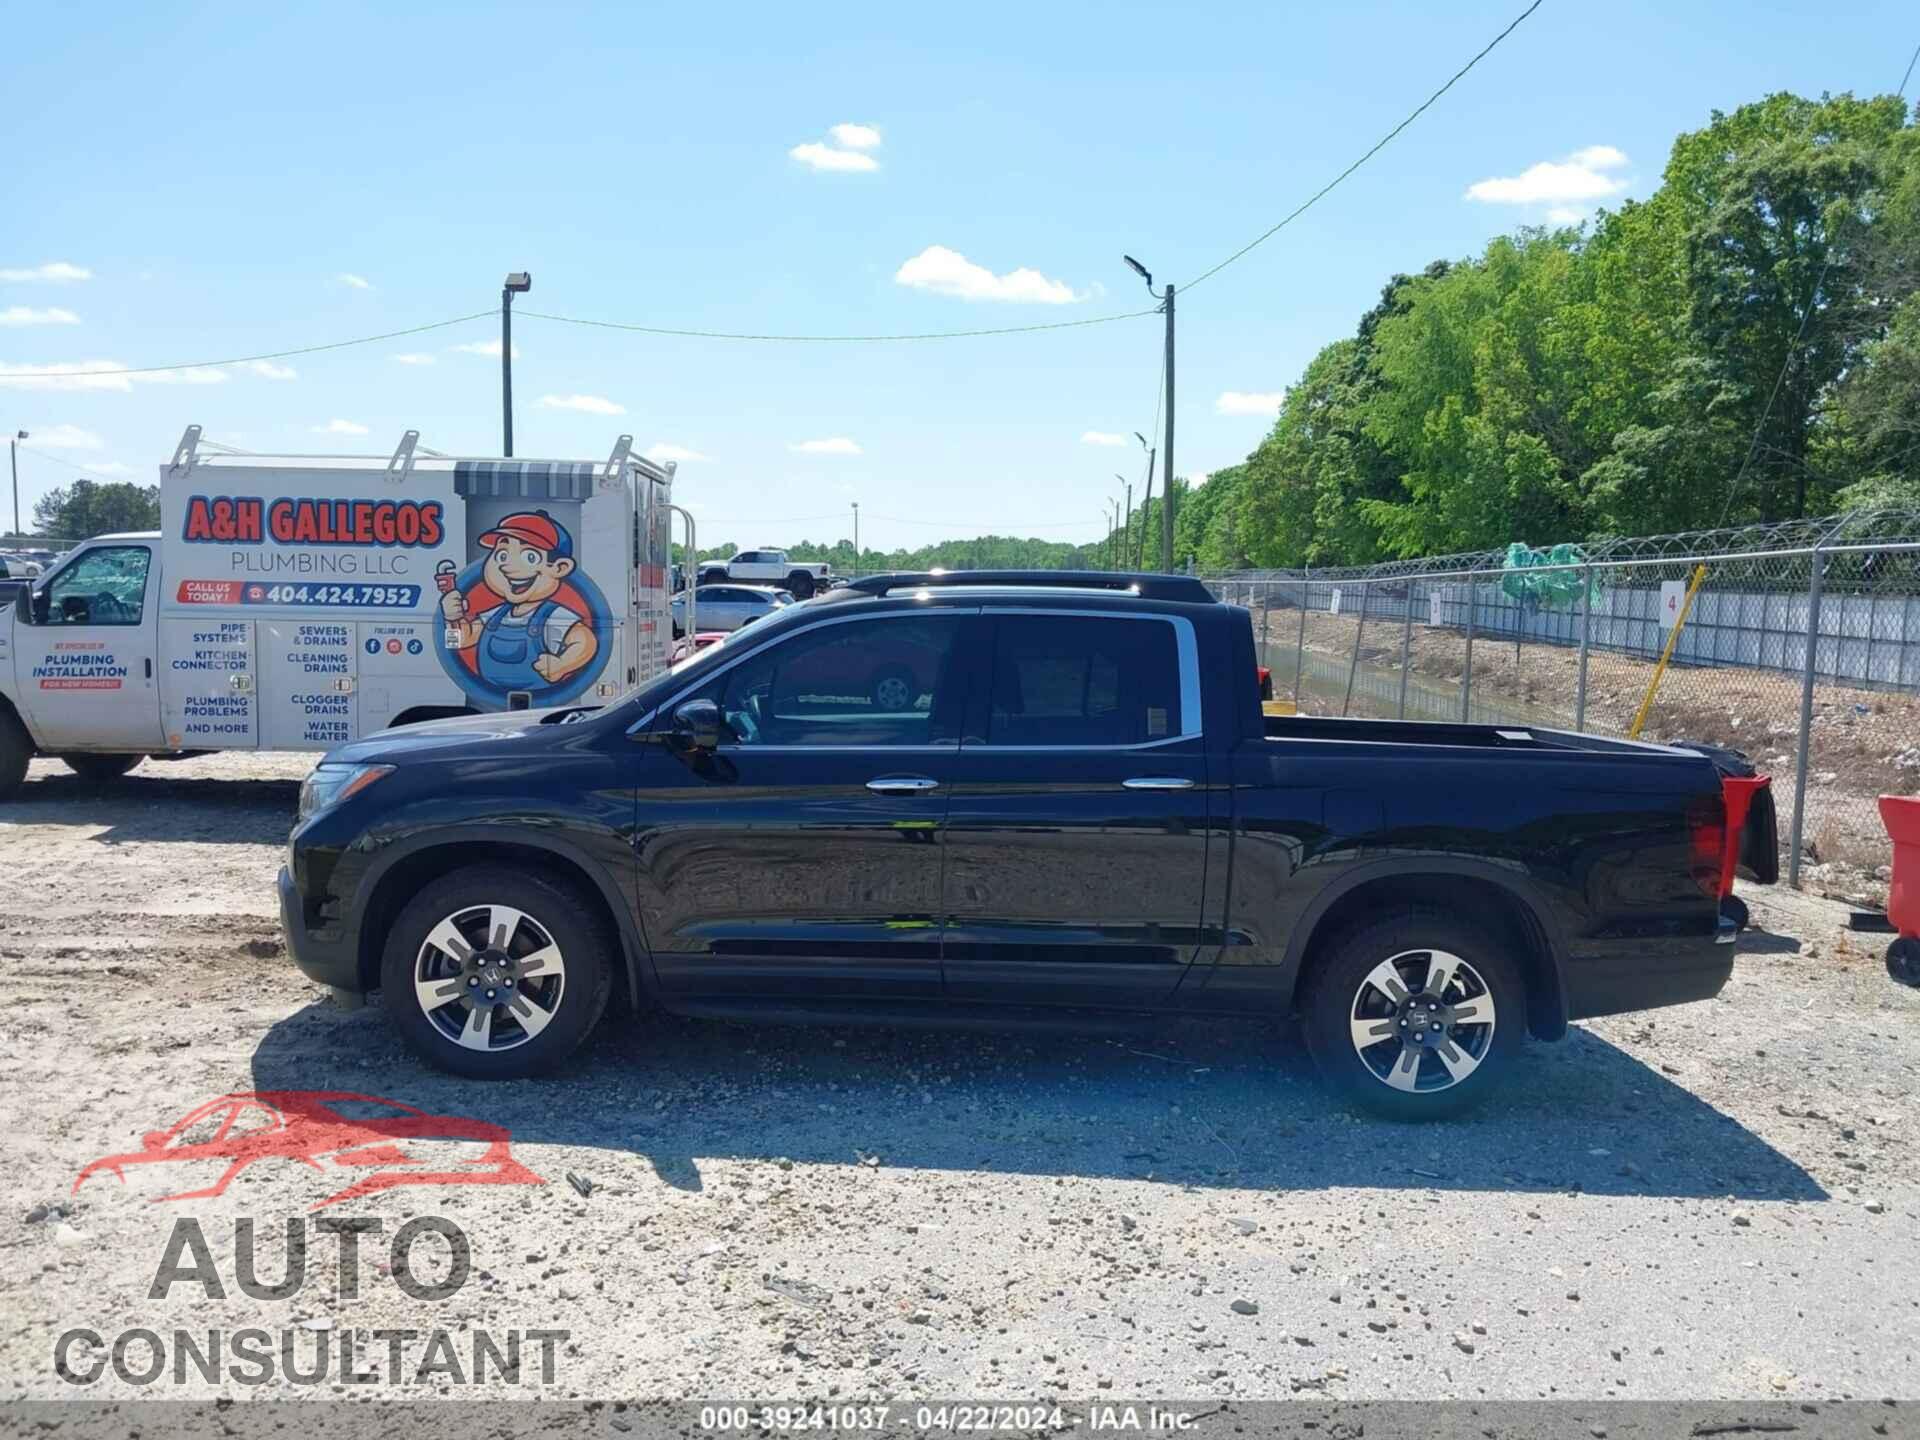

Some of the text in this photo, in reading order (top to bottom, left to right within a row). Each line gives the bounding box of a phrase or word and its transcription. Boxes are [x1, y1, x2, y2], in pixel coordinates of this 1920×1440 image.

[184, 496, 444, 548] A&H GALLEGOS
[232, 552, 409, 575] PLUMBING LLC
[187, 583, 231, 593] CALL US
[267, 586, 412, 604] 404.424.7952
[1668, 595, 1677, 611] 4
[221, 623, 246, 632] PIPE
[299, 626, 347, 635] SEWERS
[193, 633, 247, 642] SYSTEMS
[303, 637, 347, 646] DRAINS
[195, 650, 247, 660] KITCHEN
[287, 653, 347, 663] CLEANING
[45, 655, 114, 665] PLUMBING
[172, 660, 247, 670] CONNECTOR
[304, 664, 348, 673] DRAINS
[33, 666, 128, 677] INSTALLATION
[186, 697, 248, 706] PLUMBING
[184, 707, 248, 716] PROBLEMS
[305, 705, 348, 714] DRAINS
[185, 724, 248, 733] AND MORE
[308, 722, 348, 731] WATER
[304, 732, 348, 741] HEATER
